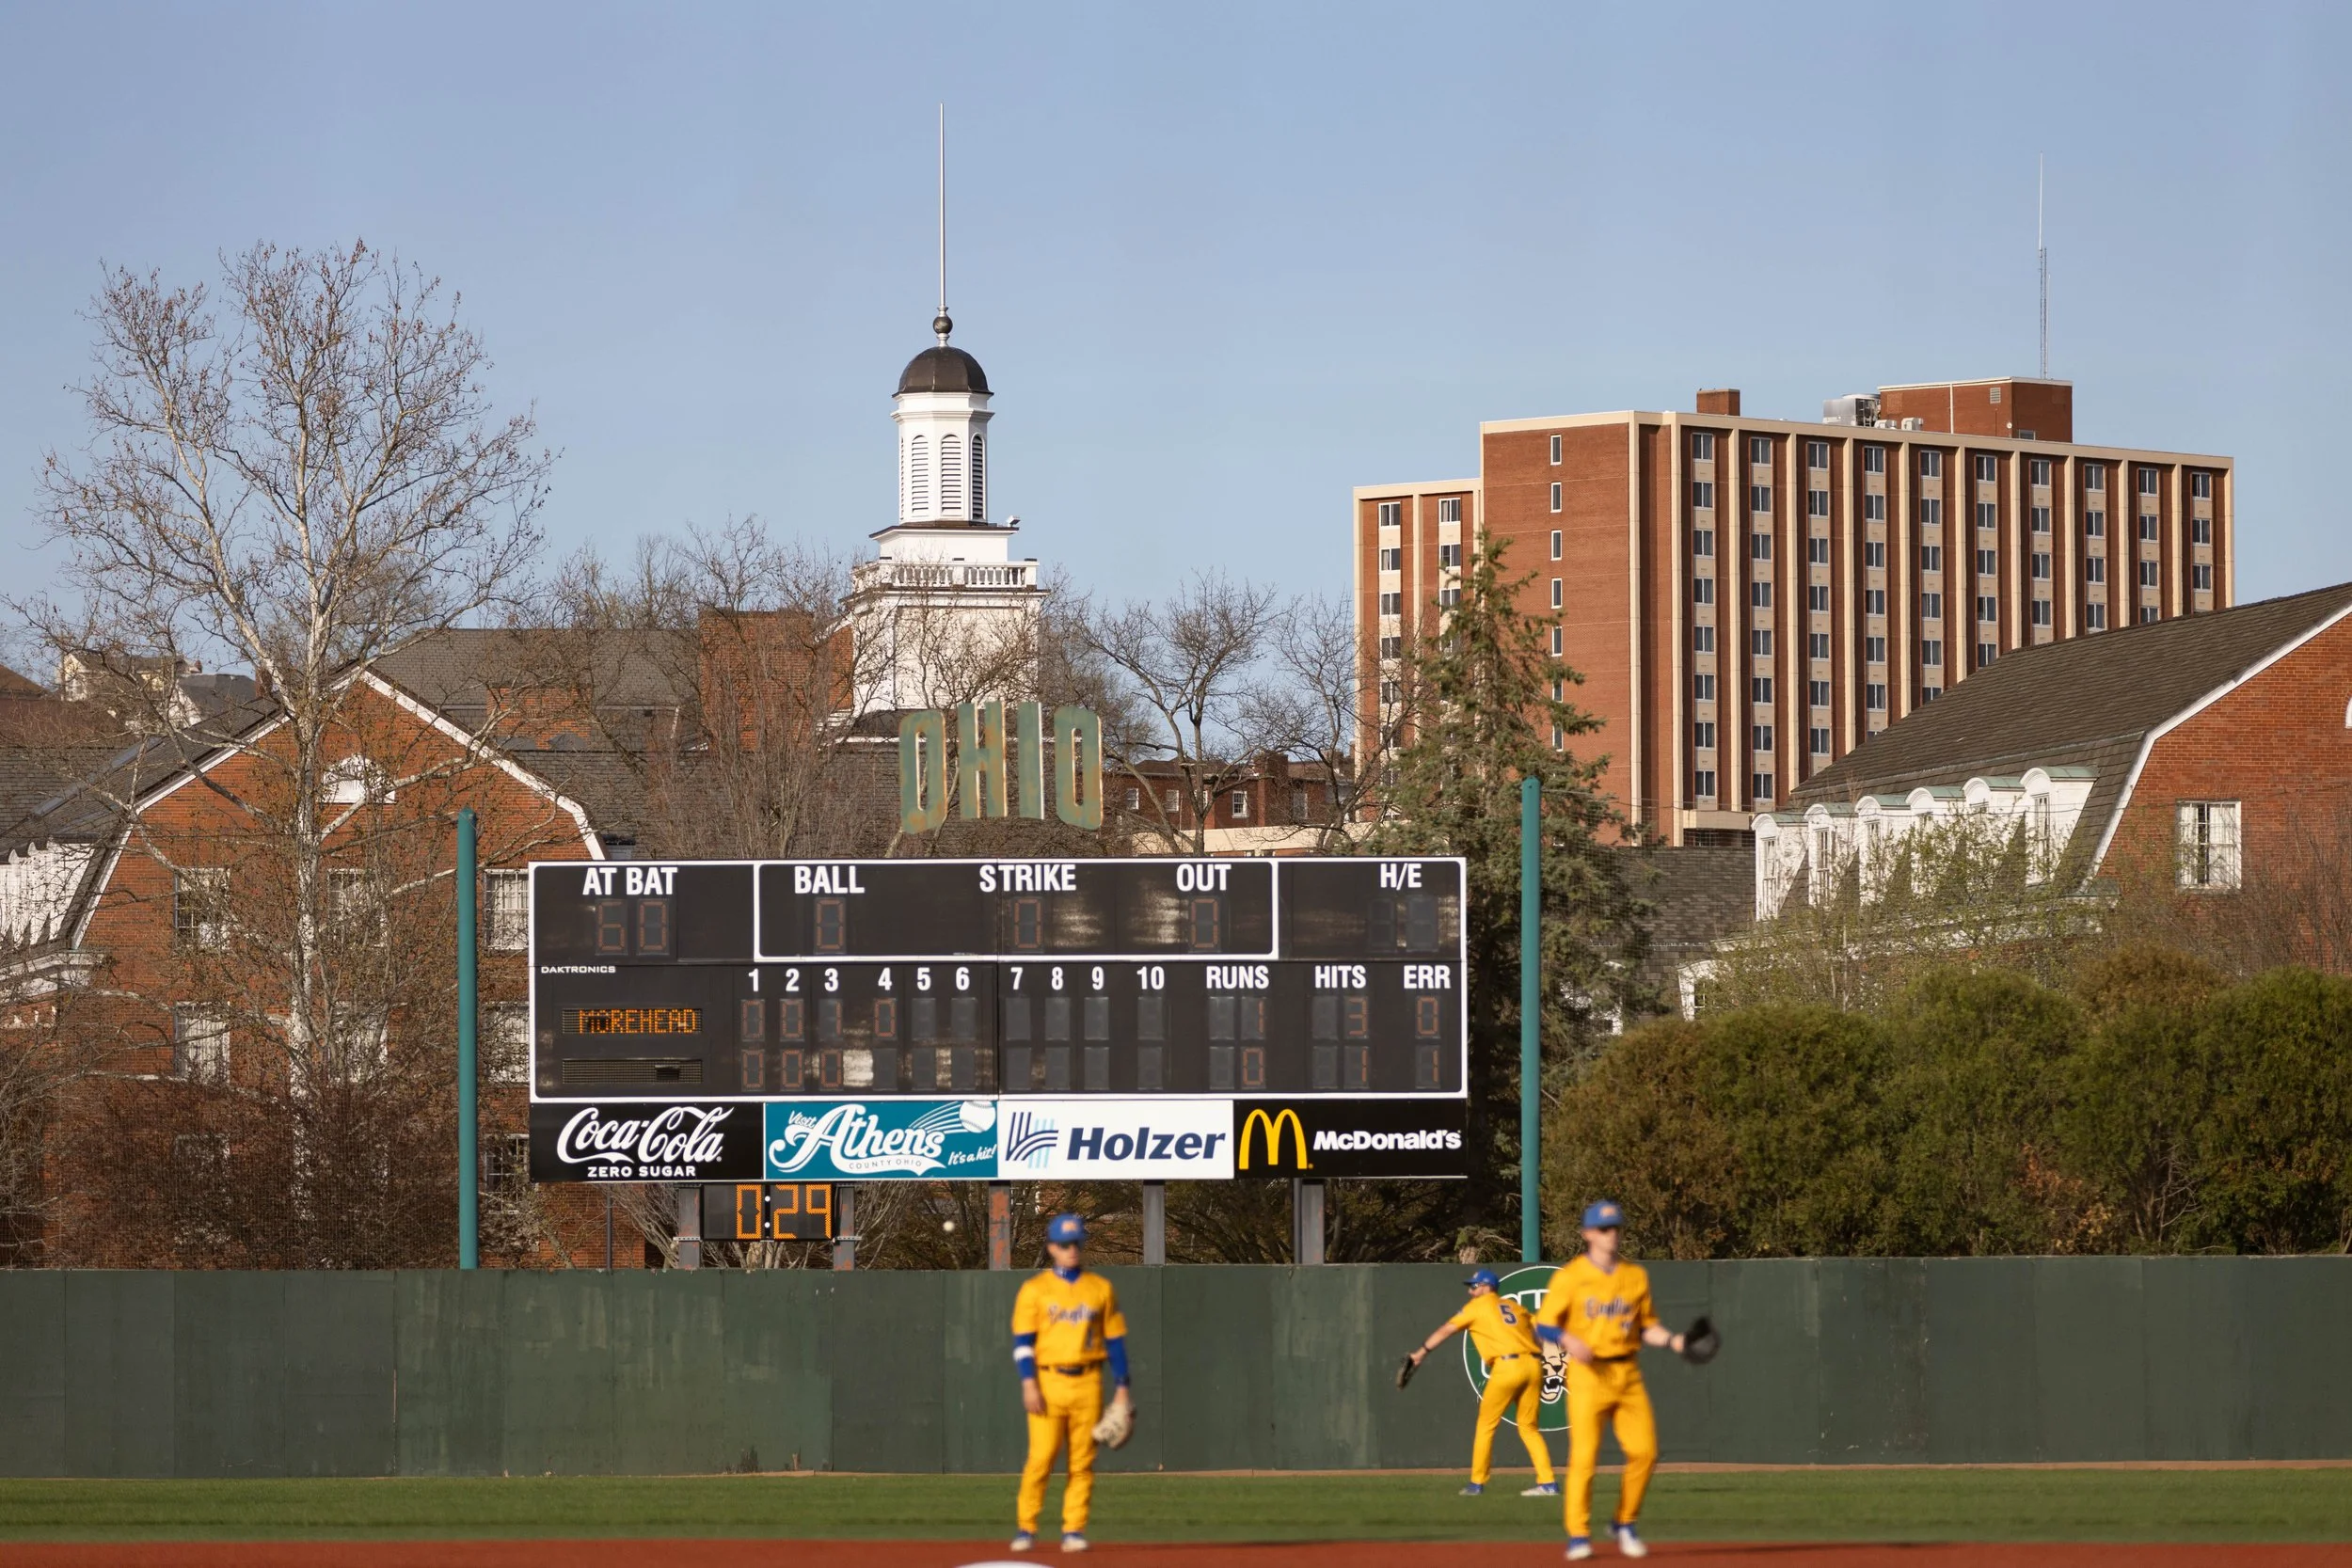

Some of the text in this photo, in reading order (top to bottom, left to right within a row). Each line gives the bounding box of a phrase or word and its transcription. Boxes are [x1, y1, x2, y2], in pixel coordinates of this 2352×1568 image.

[898, 701, 1104, 833] OHIO
[582, 867, 677, 895] AT BAT
[794, 865, 865, 894] BALL
[979, 864, 1076, 893] STRIKE
[1176, 863, 1232, 892] OUT
[1380, 863, 1422, 891] H/E
[748, 965, 1452, 991] 1 2 3 4 5 6 7 8 9 10 RUNS HITS ERR
[579, 1008, 696, 1034] MOREHEAD
[788, 1110, 817, 1129] Visit
[557, 1106, 735, 1164] Coca-Cola
[769, 1103, 946, 1176] Athens
[1067, 1127, 1226, 1161] Holzer
[1313, 1130, 1461, 1151] McDonald's
[849, 1158, 922, 1170] COUNTY OHIO
[947, 1150, 966, 1165] It's
[976, 1143, 997, 1161] hit!
[588, 1165, 696, 1178] ZERO SUGAR
[736, 1183, 832, 1240] 0:29
[1499, 1303, 1518, 1326] 5
